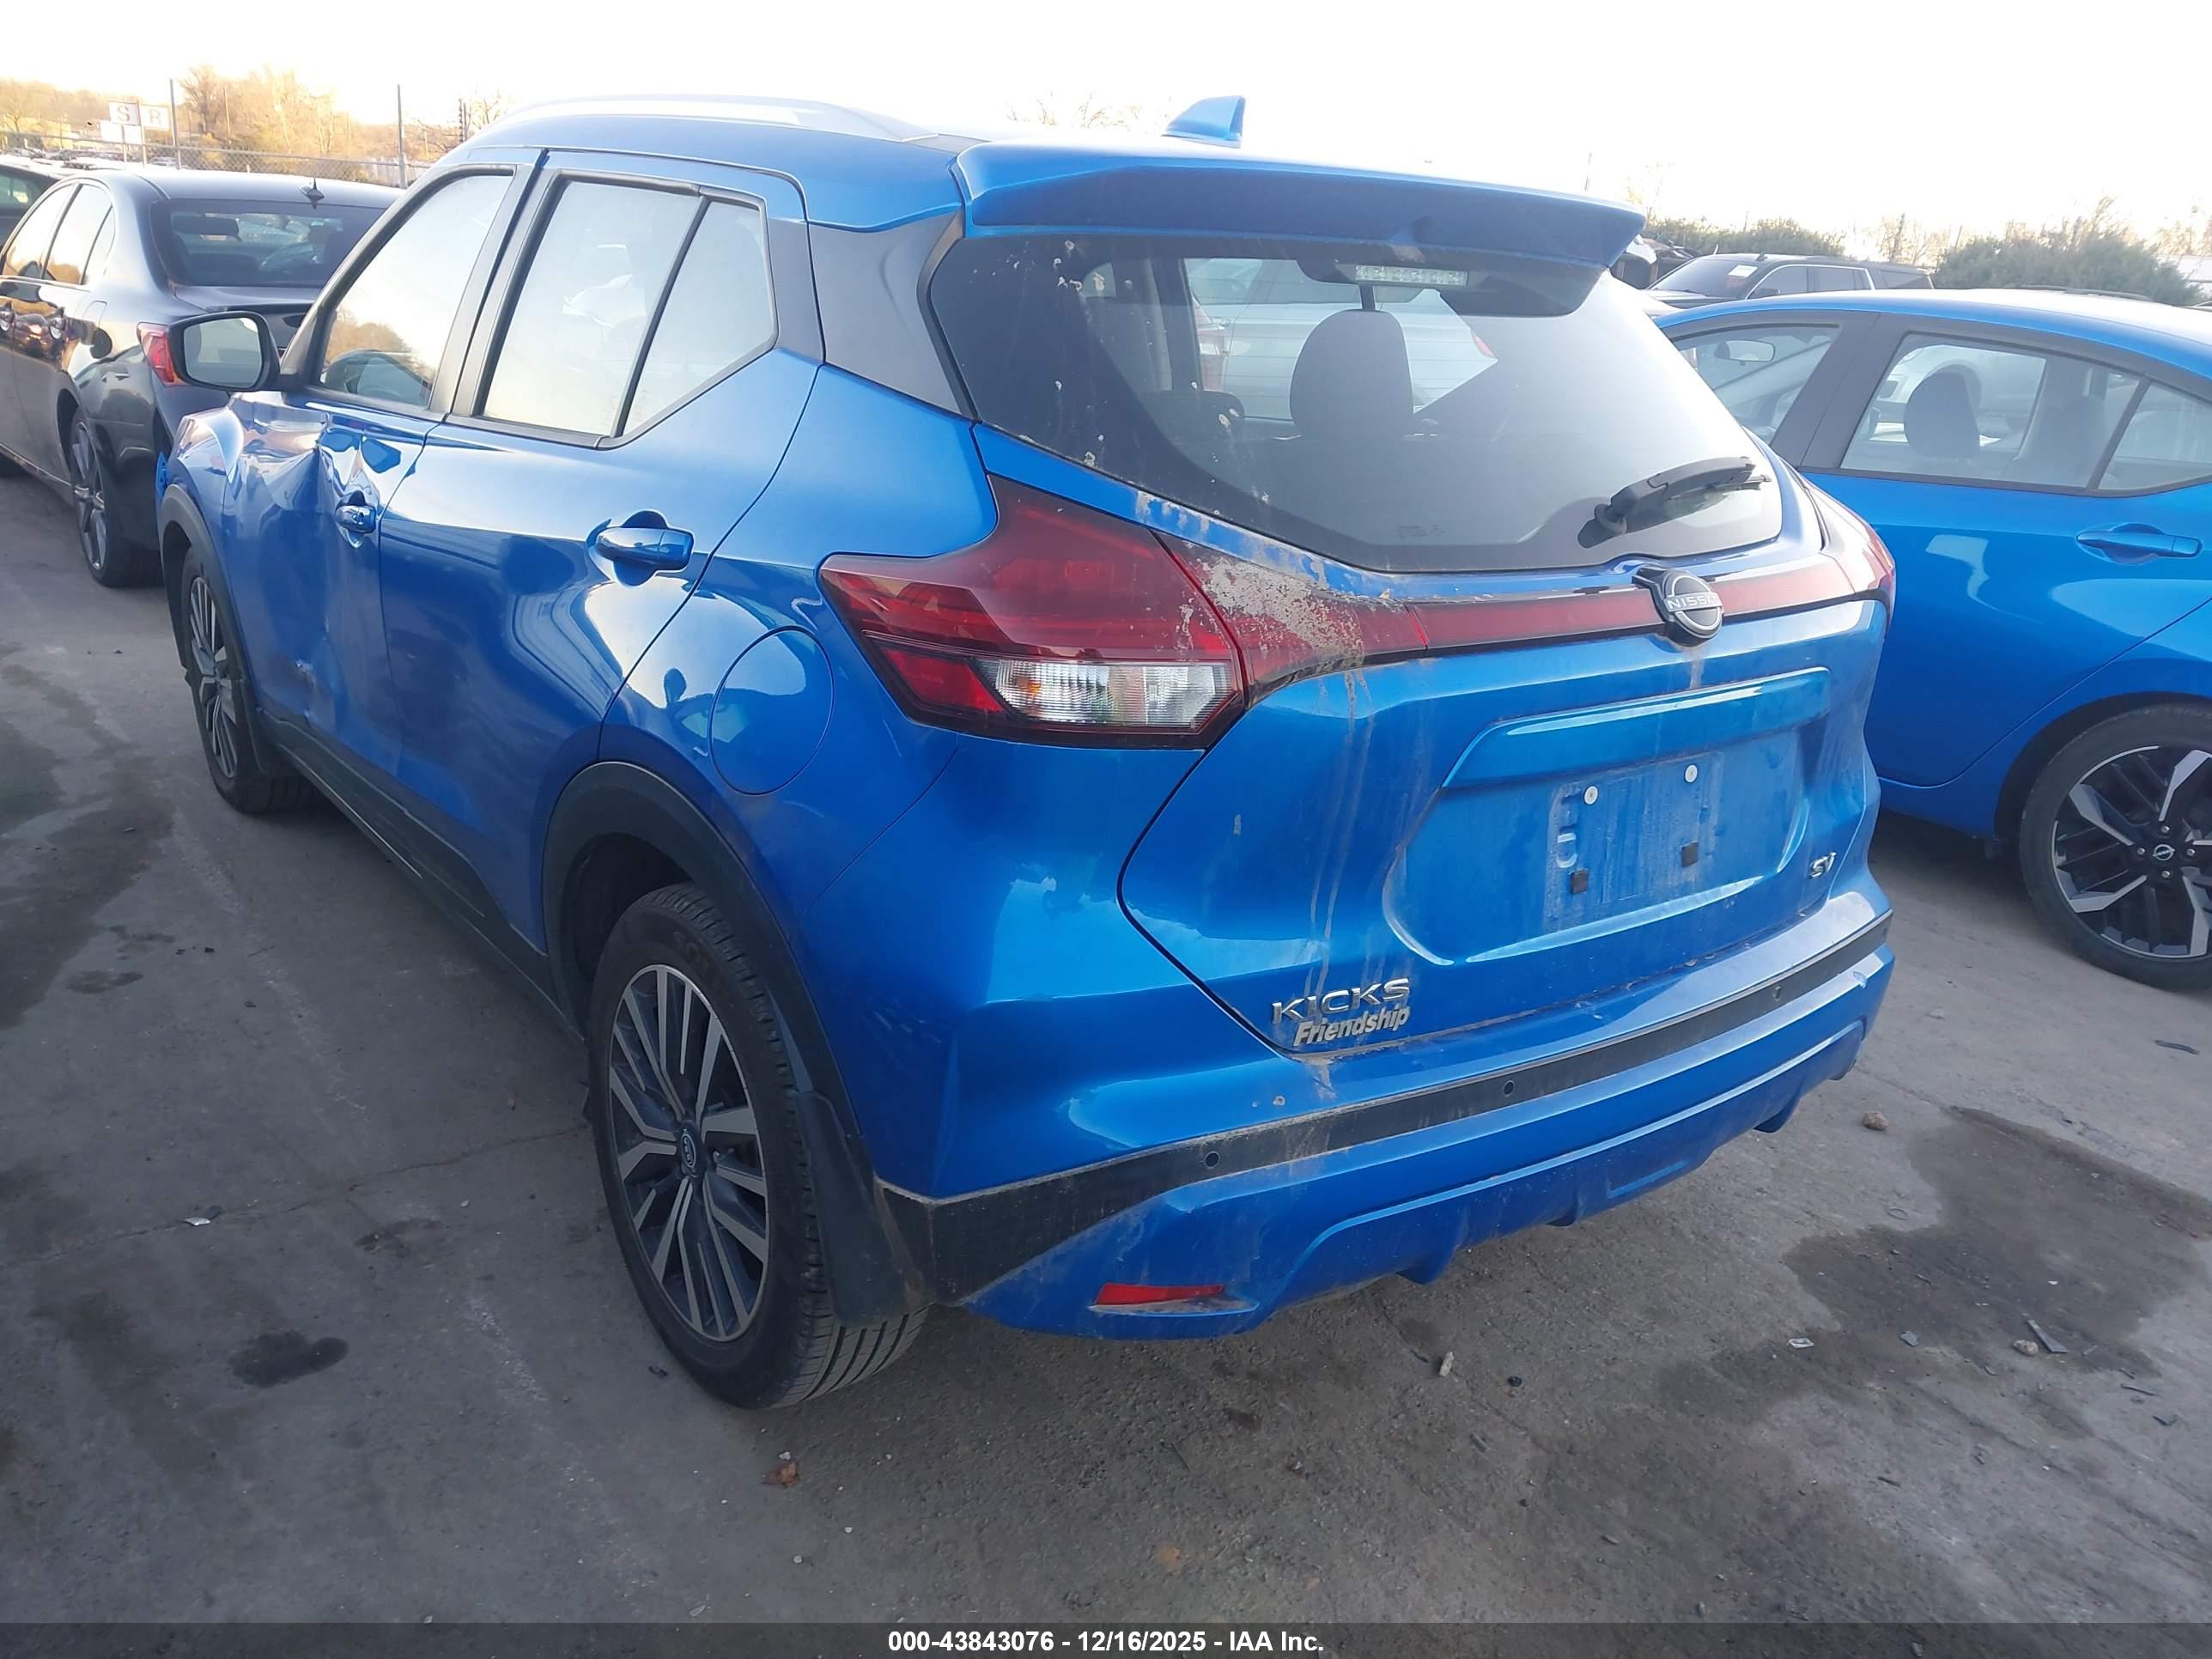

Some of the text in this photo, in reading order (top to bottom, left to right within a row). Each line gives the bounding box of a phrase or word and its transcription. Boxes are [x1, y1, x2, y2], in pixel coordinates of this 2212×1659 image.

[117, 105, 131, 123] S
[149, 109, 162, 125] R
[1271, 977, 1410, 1024] KICKS
[1292, 1003, 1411, 1047] Friendship
